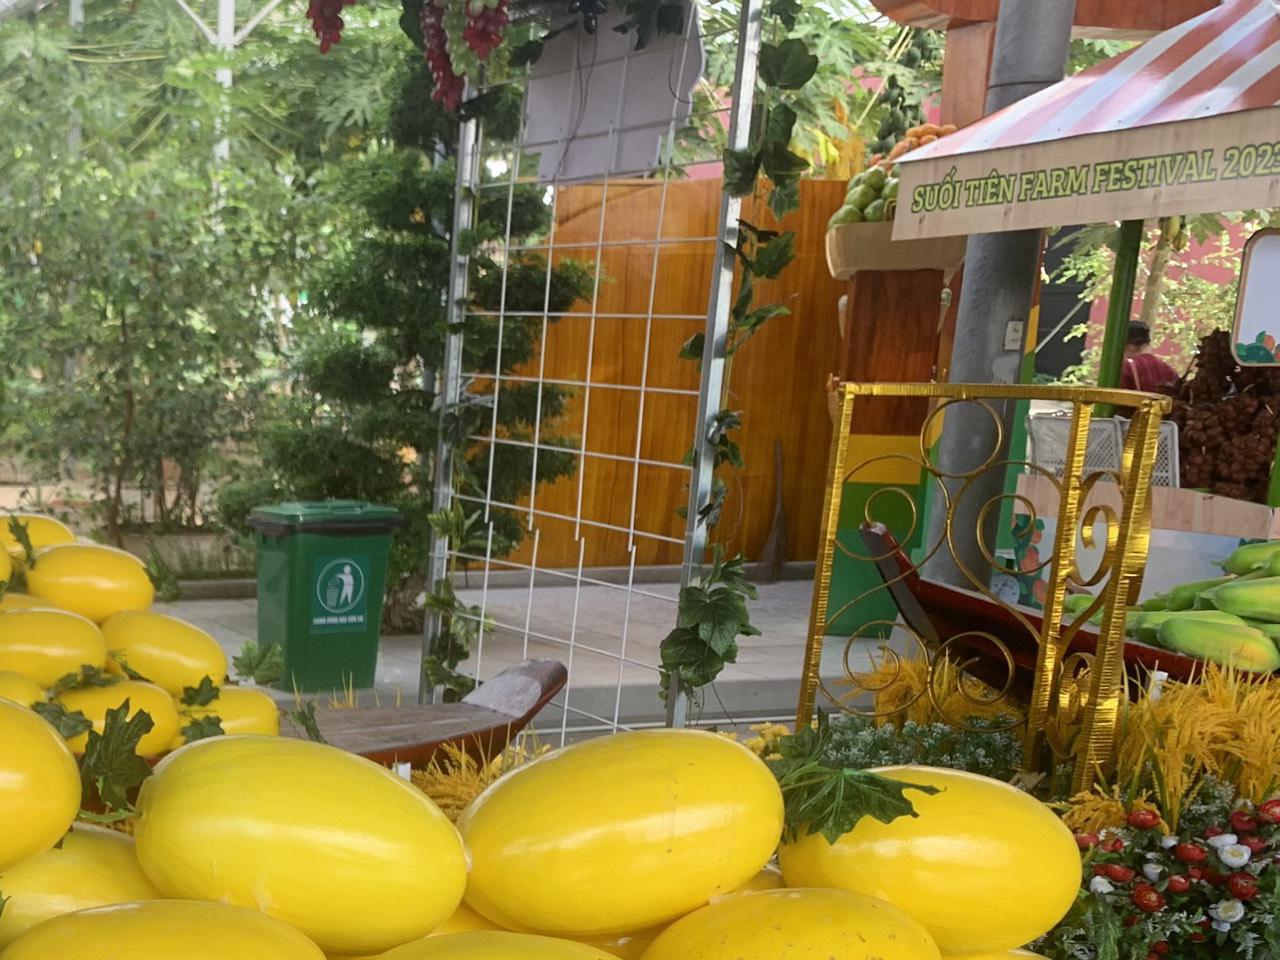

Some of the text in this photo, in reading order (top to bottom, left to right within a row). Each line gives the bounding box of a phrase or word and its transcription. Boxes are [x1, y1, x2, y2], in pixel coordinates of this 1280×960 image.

[912, 166, 962, 213] SUỐI
[964, 168, 1017, 207] TIÊN
[1017, 164, 1090, 202] FARM
[1091, 149, 1217, 193] FESTIVAL
